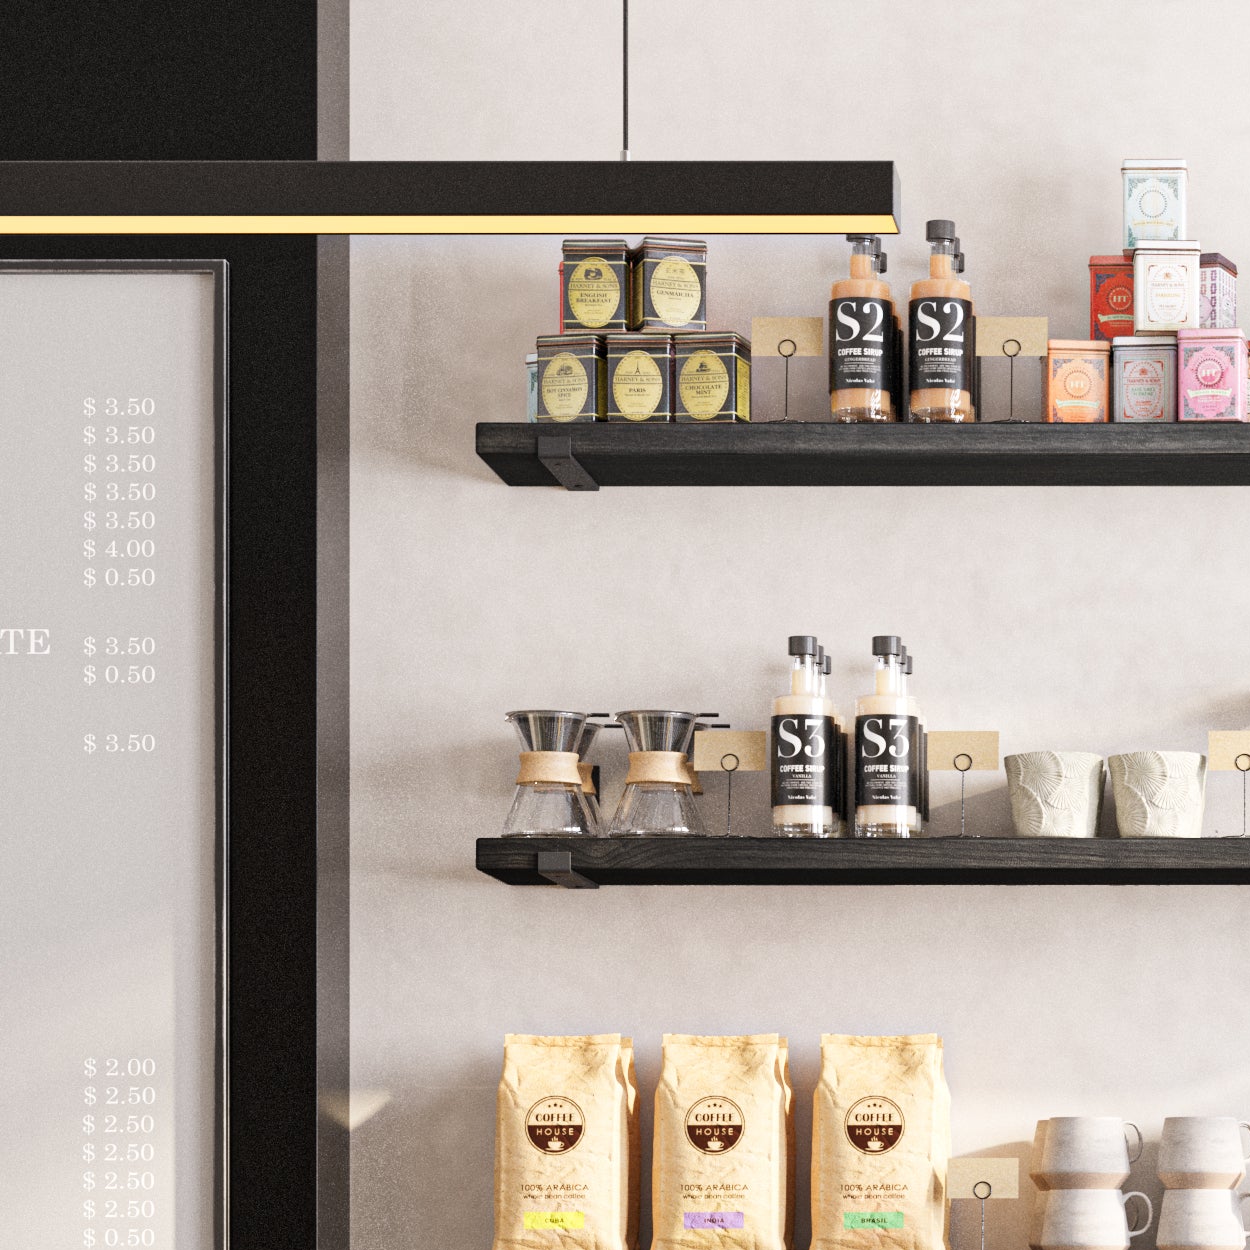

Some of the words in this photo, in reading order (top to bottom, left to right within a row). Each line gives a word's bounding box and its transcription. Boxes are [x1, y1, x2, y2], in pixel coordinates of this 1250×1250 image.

[836, 302, 884, 342] S2
[916, 302, 964, 342] S2
[838, 348, 862, 356] COFFEE
[864, 348, 883, 356] SIRUP
[918, 348, 942, 356] COFFEE
[944, 348, 963, 356] SIRUP
[106, 398, 156, 416] 3.50
[106, 427, 156, 444] 3.50
[106, 455, 156, 472] 3.50
[106, 484, 156, 500] 3.50
[106, 512, 156, 529] 3.50
[106, 540, 156, 557] 4.00
[106, 569, 156, 586] 0.50
[106, 638, 156, 655] 3.50
[106, 666, 156, 683] 0.50
[106, 735, 156, 752] 3.50
[778, 718, 825, 758] S3
[862, 718, 910, 758] S3
[780, 764, 804, 772] COFFEE
[805, 764, 825, 772] SIRUP
[864, 764, 888, 772] COFFEE
[890, 764, 909, 772] SIRUP
[106, 1059, 156, 1076] 2.00
[106, 1087, 156, 1104] 2.50
[104, 1115, 155, 1132] 2.50
[535, 1113, 573, 1122] COFFEE
[695, 1113, 733, 1122] COFFEE
[855, 1113, 893, 1122] COFFEE
[536, 1128, 574, 1136] HOUSE
[696, 1128, 734, 1136] HOUSE
[856, 1128, 894, 1136] HOUSE
[104, 1144, 155, 1161] 2.50
[104, 1172, 155, 1189] 2.50
[104, 1200, 155, 1218] 2.50
[104, 1228, 155, 1246] 0.50
